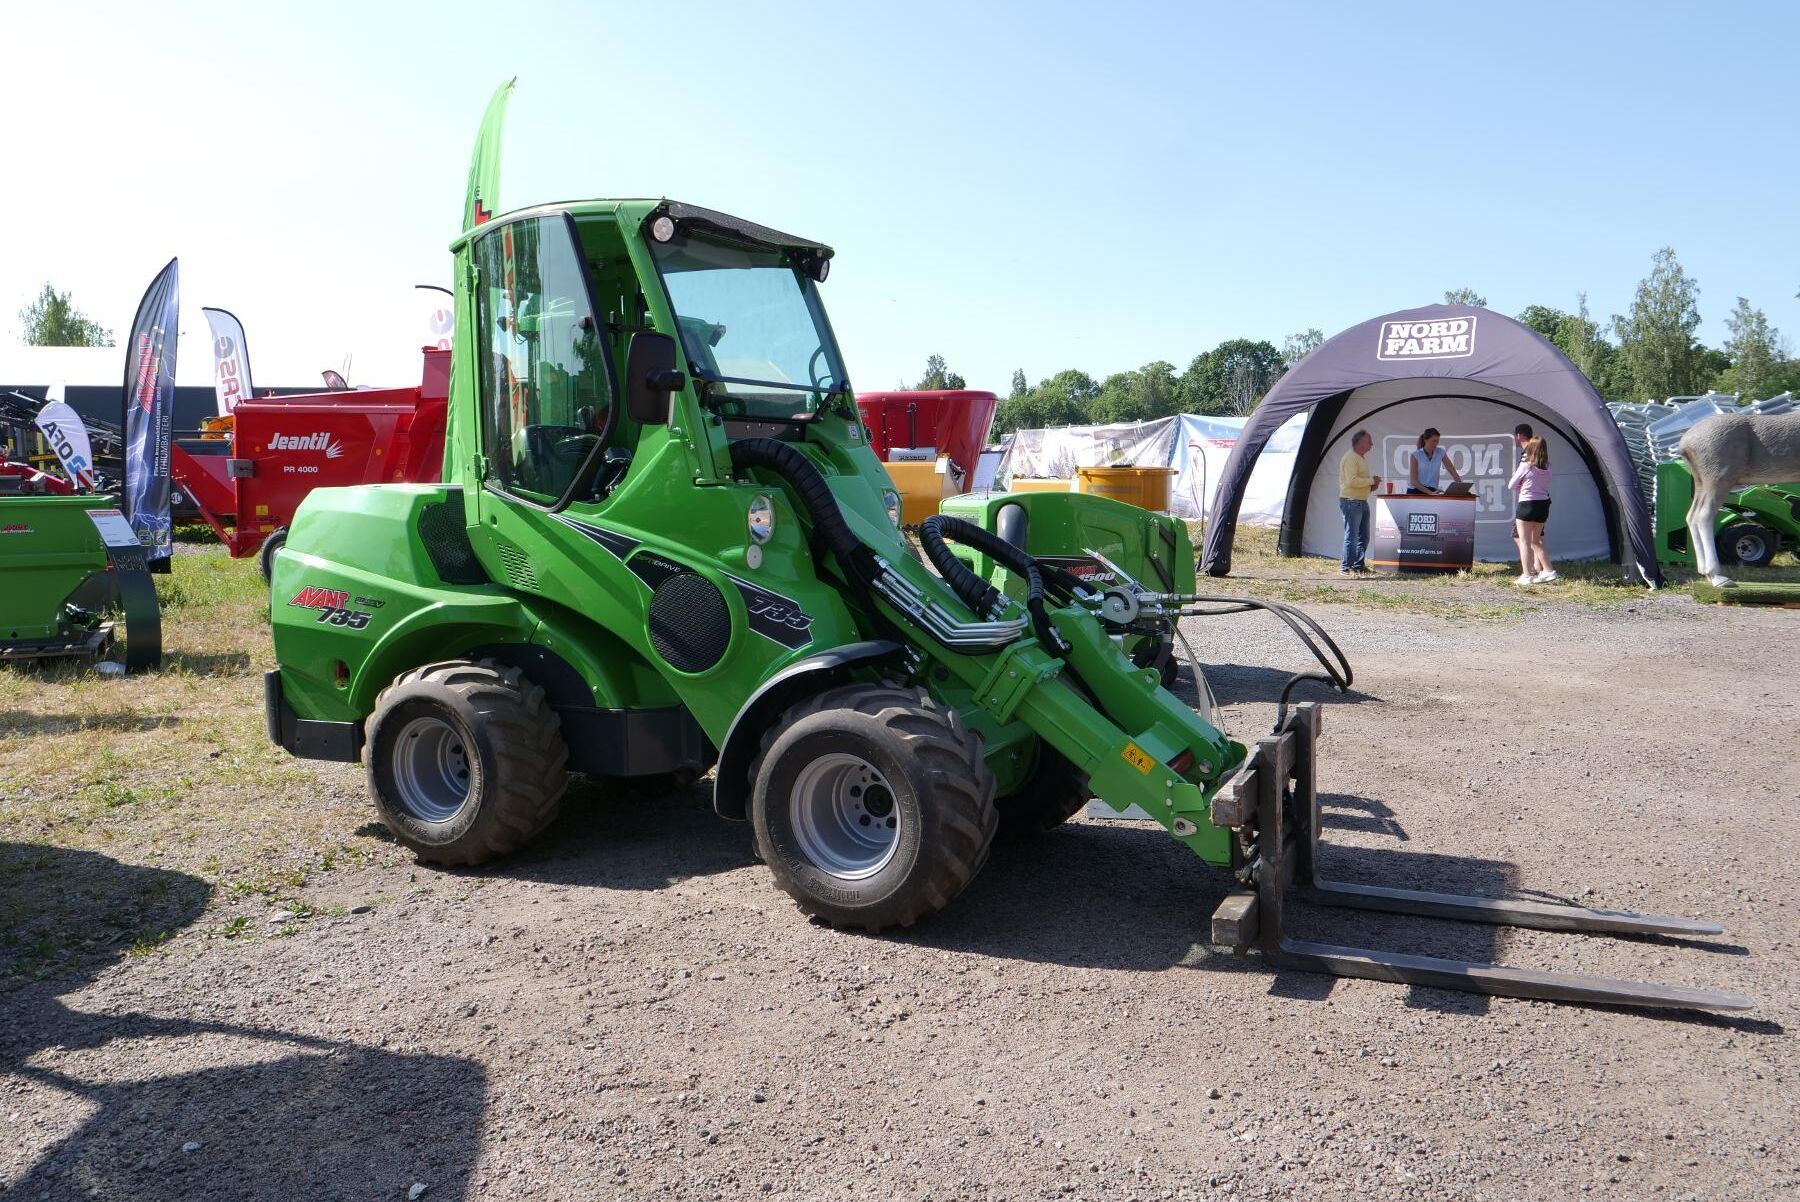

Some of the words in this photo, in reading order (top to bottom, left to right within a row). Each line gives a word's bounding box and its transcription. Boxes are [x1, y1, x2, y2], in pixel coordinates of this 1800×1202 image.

[1388, 320, 1469, 338] NORD
[1384, 335, 1469, 355] FARM
[136, 333, 159, 414] AVANT
[159, 415, 169, 477] LITHIUMBATTERI
[267, 432, 330, 450] Jeantil
[1409, 523, 1436, 532] FARM
[1410, 514, 1436, 524] NORD
[288, 585, 350, 610] AVANT
[316, 606, 373, 631] 735
[748, 595, 815, 630] 735
